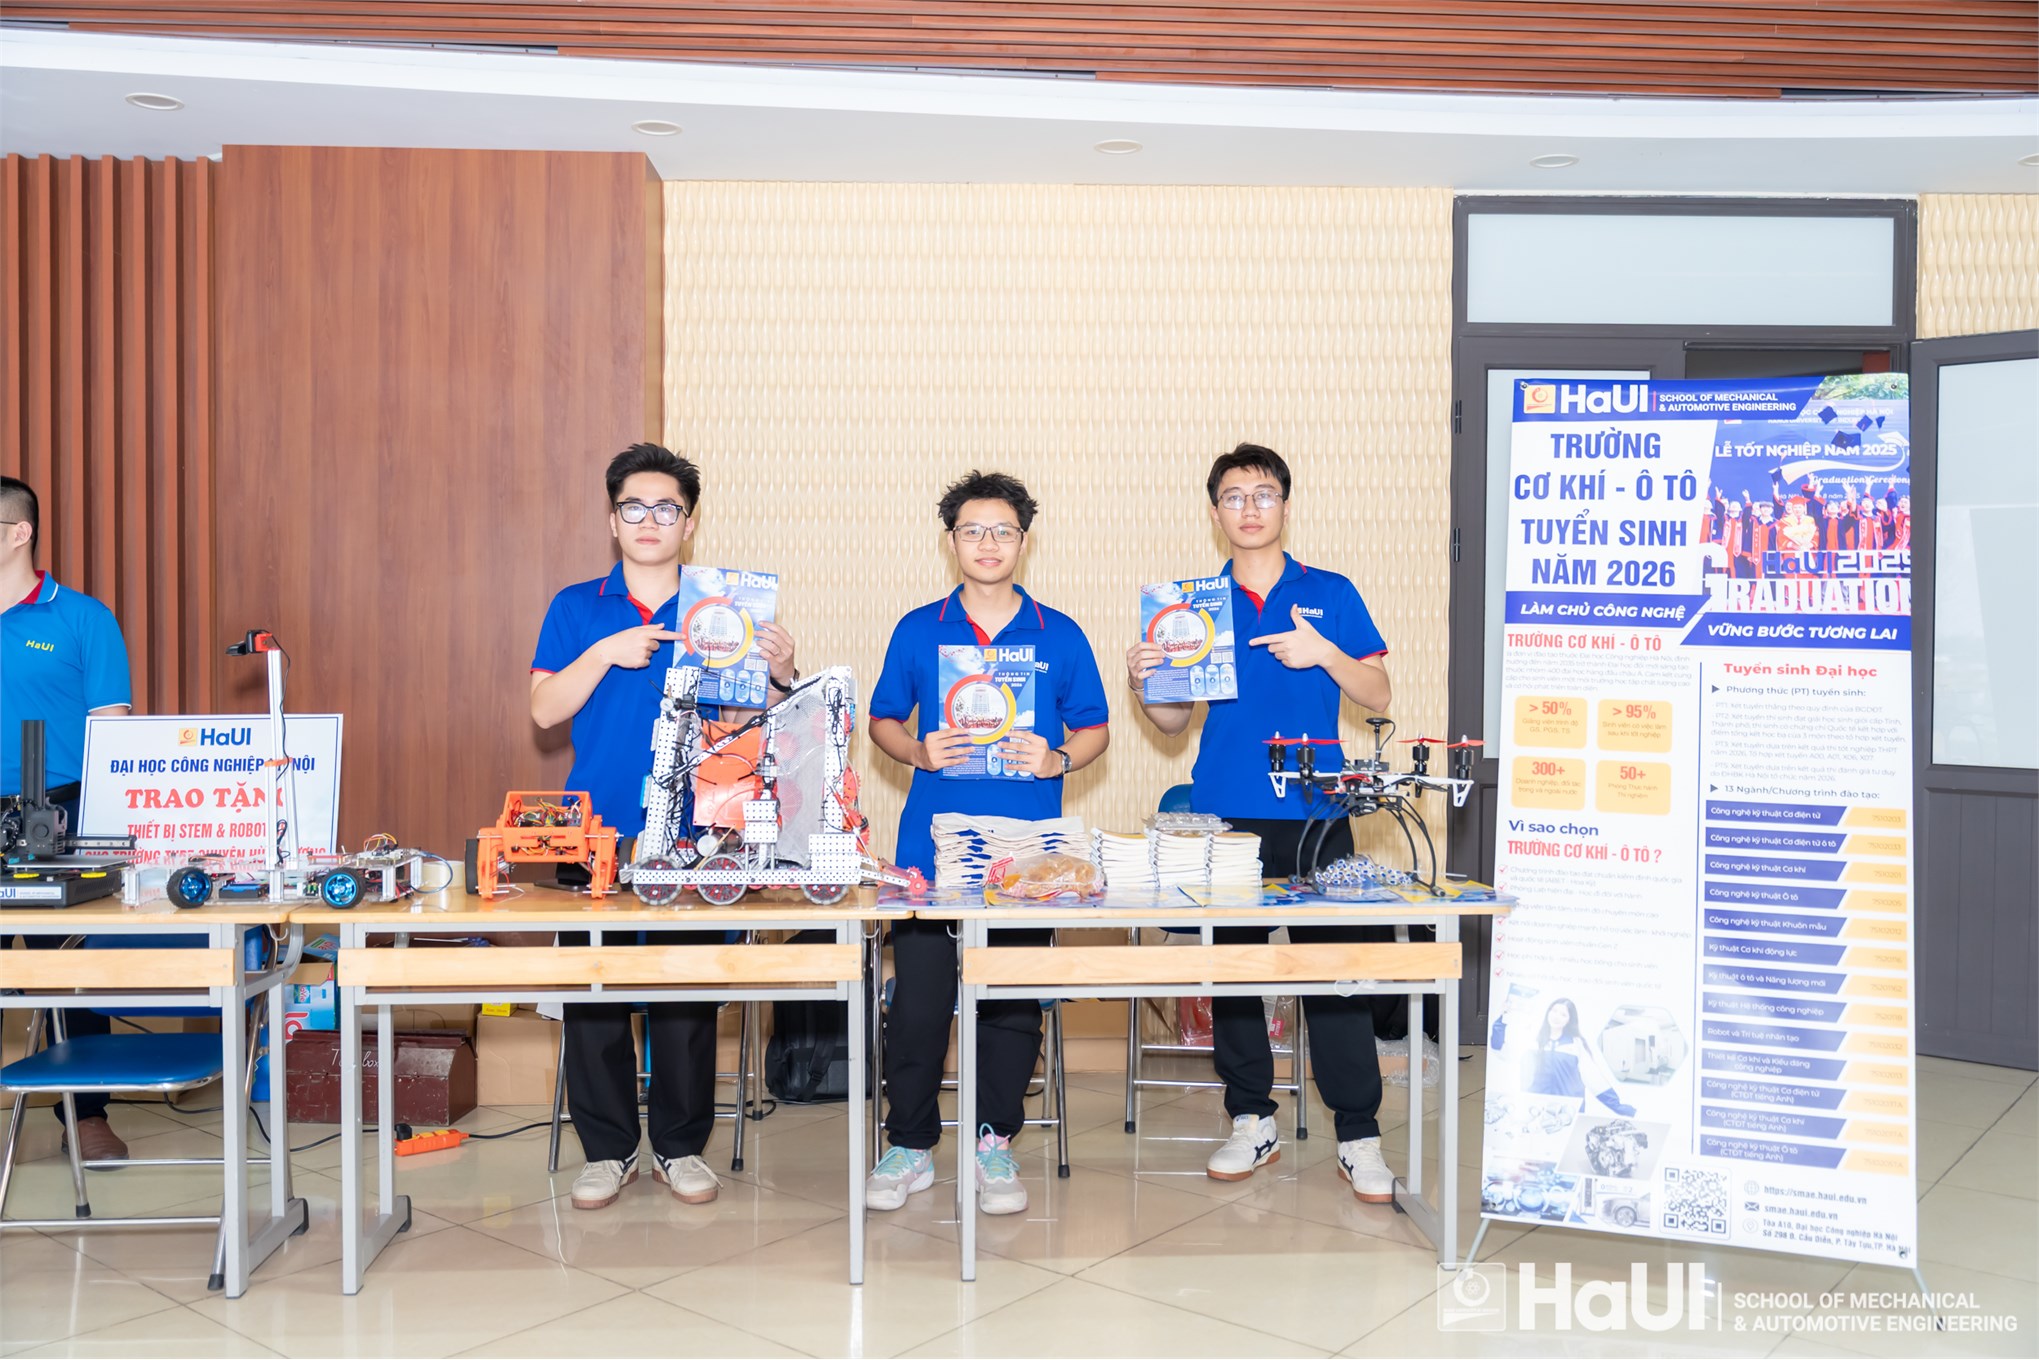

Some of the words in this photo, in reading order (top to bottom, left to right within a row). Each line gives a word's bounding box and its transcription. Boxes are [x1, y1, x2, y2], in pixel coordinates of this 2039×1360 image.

[1560, 384, 1649, 414] HaUI
[1659, 394, 1698, 402] SCHOOL
[1714, 393, 1778, 401] MECHANICAL
[1659, 404, 1667, 412] &
[1669, 403, 1730, 412] AUTOMOTIVE
[1732, 403, 1796, 411] ENGINEERING
[1551, 426, 1661, 459] TRƯỜNG
[1715, 441, 1732, 458] LỄ
[1734, 441, 1764, 457] TỐT
[1766, 441, 1823, 459] NGHIỆP
[1862, 444, 1897, 456] 2025
[1514, 472, 1551, 500] CƠ
[1560, 469, 1606, 500] KHÍ
[1636, 469, 1653, 501] Ô
[1664, 469, 1697, 501] TÔ
[1521, 508, 1608, 545] TUYỂN
[1619, 520, 1687, 546] SINH
[1532, 553, 1596, 585] NĂM
[1606, 560, 1676, 587] 2026
[1762, 551, 1833, 574] HaUI
[1195, 577, 1228, 591] HaUI
[1302, 607, 1324, 616] HaUI
[1520, 602, 1554, 615] LÀM
[1557, 602, 1591, 616] CHỦ
[1593, 603, 1638, 618] CÔNG
[1641, 605, 1686, 621] NGHỆ
[1708, 623, 1753, 637] VỮNG
[1757, 624, 1804, 638] BƯỚC
[1808, 625, 1867, 639] TƯƠNG
[1870, 628, 1898, 640] LAI
[25, 639, 55, 652] HaUI
[1508, 631, 1563, 649] TRƯỜNG
[1568, 634, 1587, 649] CƠ
[1591, 634, 1615, 650] KHÍ
[1630, 634, 1640, 651] Ô
[1645, 634, 1662, 651] TÔ
[998, 648, 1033, 662] HaUI
[1034, 661, 1049, 670] aUI
[1723, 661, 1772, 677] Tuyển
[1776, 664, 1810, 676] sinh
[1815, 665, 1842, 679] Đại
[1848, 666, 1877, 679] học
[1726, 685, 1764, 696] Phương
[1766, 687, 1788, 695] thức
[1791, 687, 1809, 696] (PT)
[1843, 689, 1866, 697] sinh:
[1541, 701, 1572, 716] 50%
[1625, 704, 1657, 719] 95%
[200, 728, 251, 745] HaUI
[110, 759, 134, 776] ĐẠI
[138, 759, 166, 776] HỌC
[171, 756, 208, 773] CÔNG
[213, 755, 264, 774] NGHIỆP
[292, 755, 315, 771] NỘI
[1532, 761, 1565, 776] 300+
[1620, 766, 1646, 780] 50+
[125, 788, 204, 809] TRAO
[213, 781, 283, 813] TẶN
[1725, 785, 1734, 793] 13
[1813, 789, 1838, 798] trình
[1839, 790, 1858, 799] đào
[1861, 792, 1880, 800] tạo:
[1711, 807, 1730, 816] Công
[1732, 808, 1751, 817] nghệ
[1761, 810, 1781, 819] thuật
[127, 819, 160, 839] THIẾT
[163, 824, 175, 842] BỊ
[180, 823, 212, 839] STEM
[216, 823, 224, 838] &
[1508, 820, 1524, 832] Vì
[1528, 823, 1556, 834] sao
[1560, 823, 1599, 839] chọn
[1710, 834, 1730, 843] Công
[1732, 835, 1751, 844] nghệ
[1761, 837, 1781, 846] thuật
[1507, 838, 1560, 857] TRƯỜNG
[1564, 842, 1583, 859] CƠ
[1586, 843, 1608, 860] KHÍ
[1621, 844, 1629, 862] Ô
[1633, 845, 1649, 863] TÔ
[1654, 849, 1662, 863] ?
[1709, 888, 1729, 897] Công
[1731, 890, 1750, 898] nghệ
[1761, 891, 1781, 900] thuật
[1709, 916, 1729, 925] Công
[1730, 917, 1750, 926] nghệ
[1761, 919, 1781, 928] thuật
